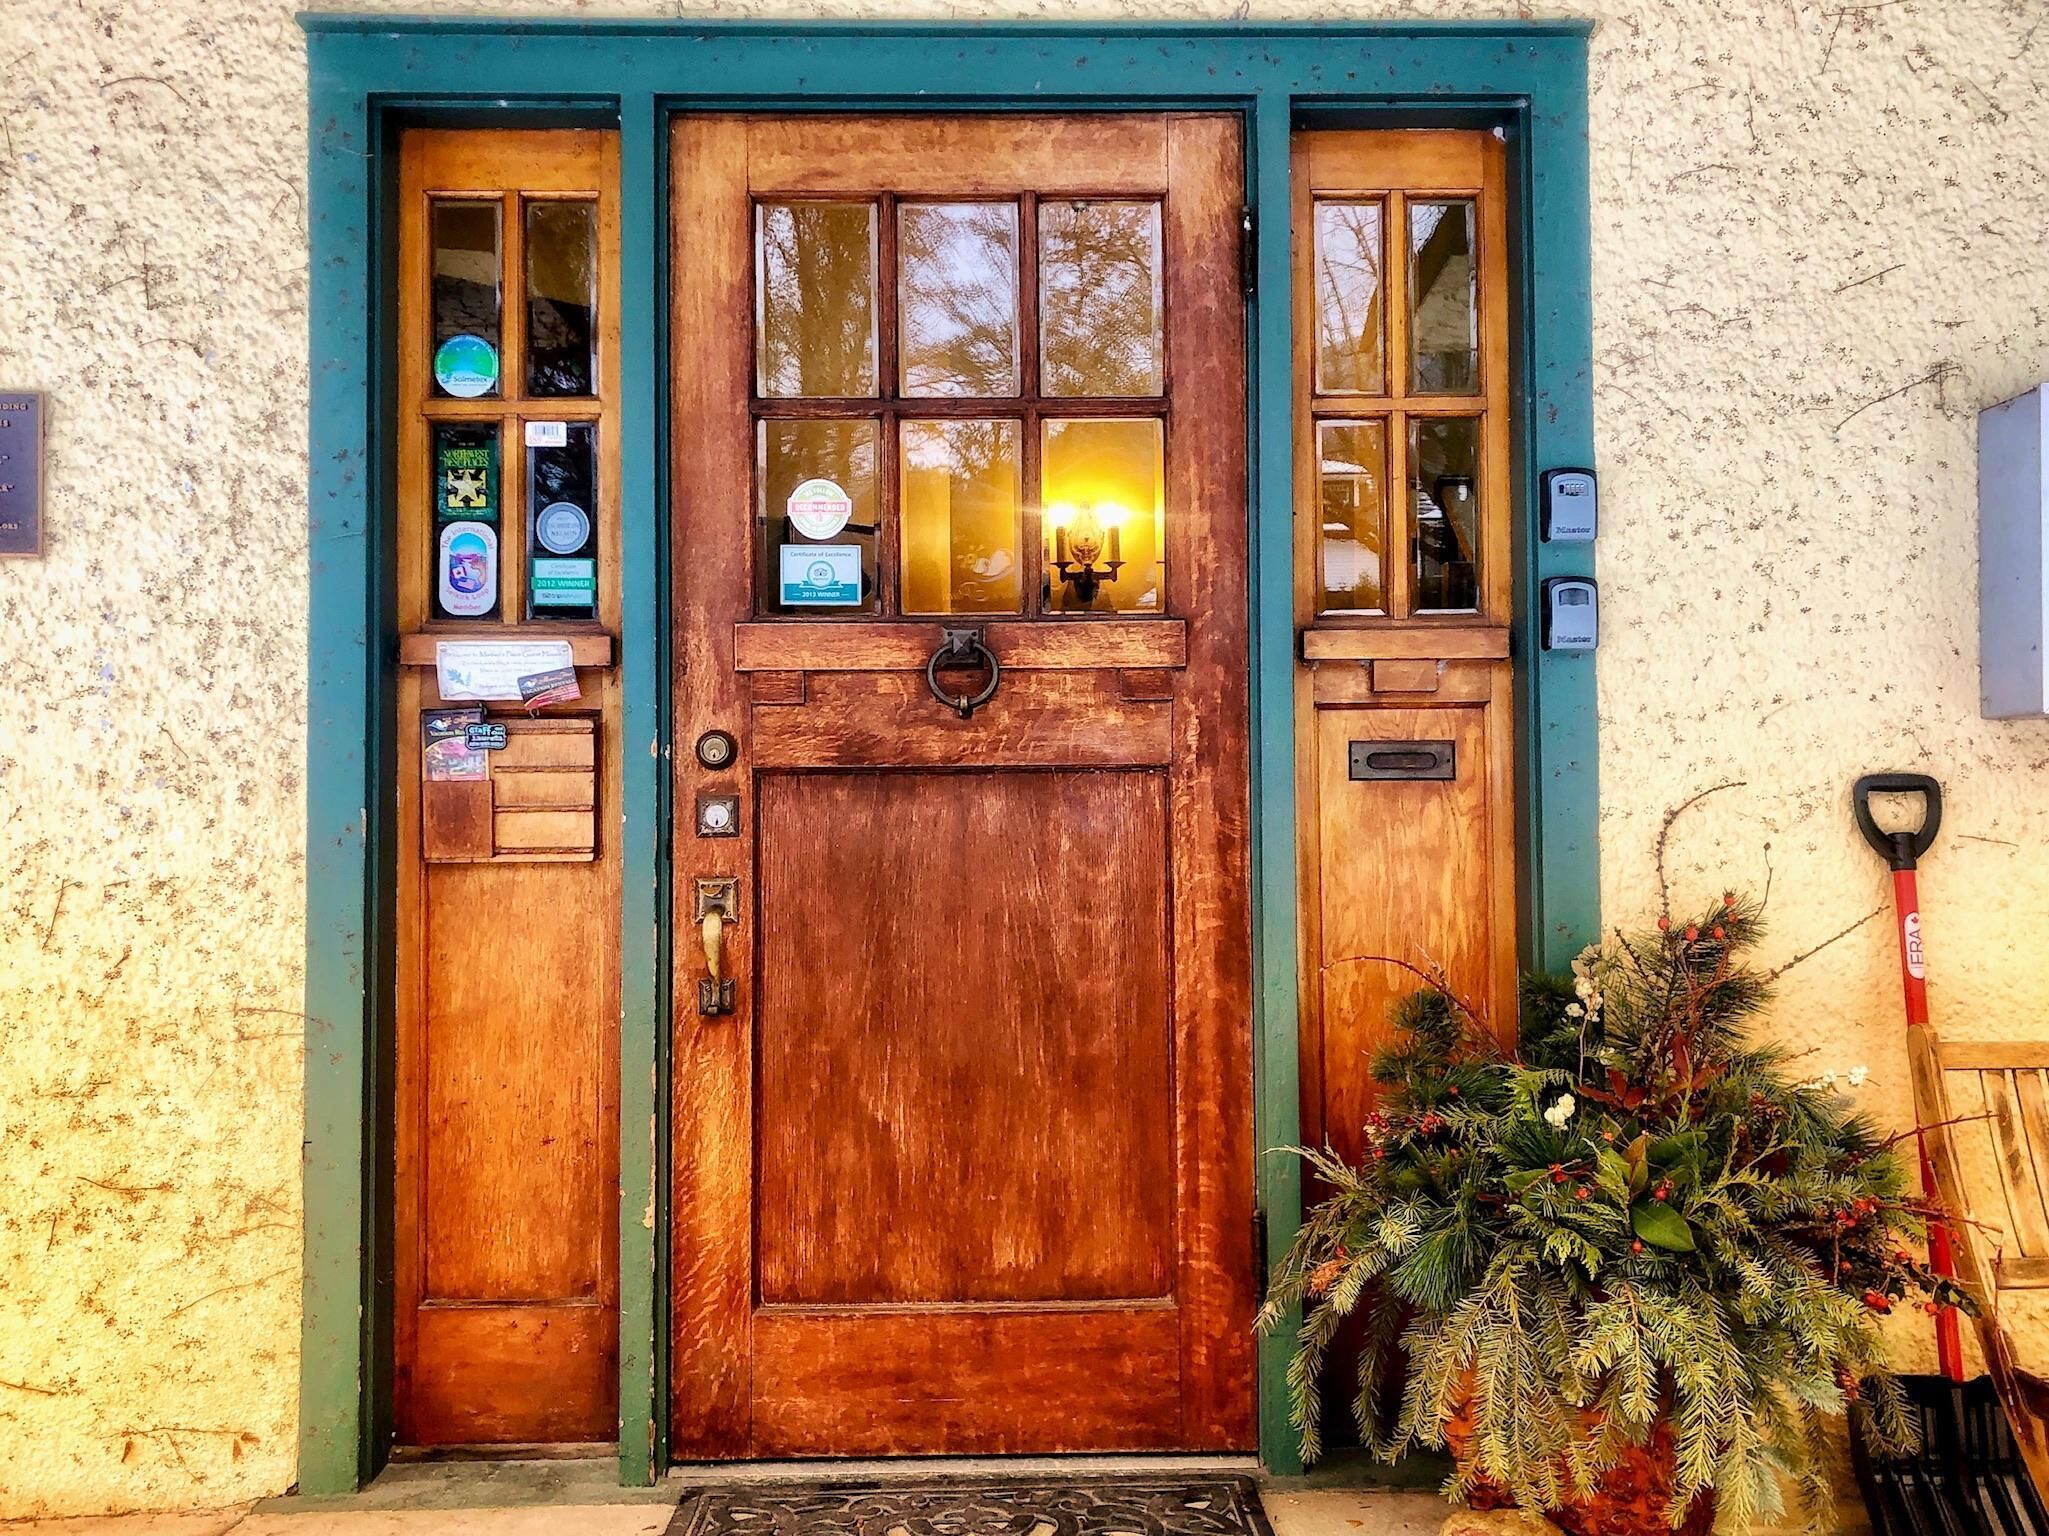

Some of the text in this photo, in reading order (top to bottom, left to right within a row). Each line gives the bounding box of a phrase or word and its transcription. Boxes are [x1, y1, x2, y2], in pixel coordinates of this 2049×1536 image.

[0, 402, 27, 411] DING
[1555, 526, 1592, 534] Master
[536, 579, 590, 588] 2012 WINNER
[1556, 635, 1592, 644] Master
